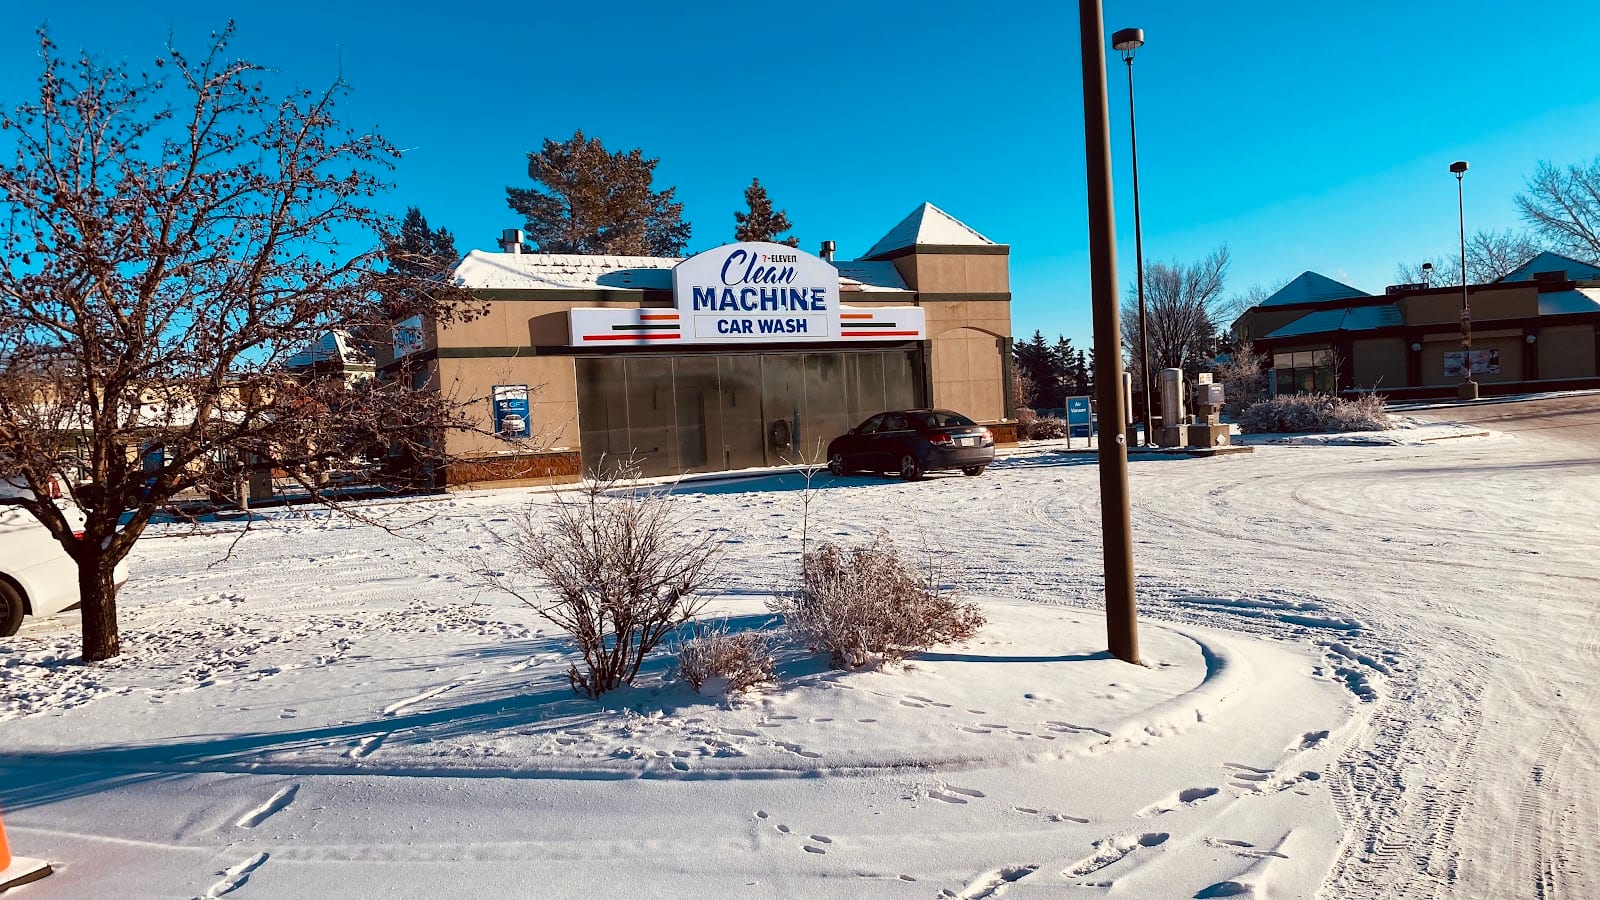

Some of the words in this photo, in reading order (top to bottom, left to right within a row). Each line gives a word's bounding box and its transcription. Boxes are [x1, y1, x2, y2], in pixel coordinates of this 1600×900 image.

[720, 249, 798, 286] Clean
[692, 286, 827, 311] MACHINE
[717, 319, 753, 334] CAR
[758, 318, 808, 334] WASH
